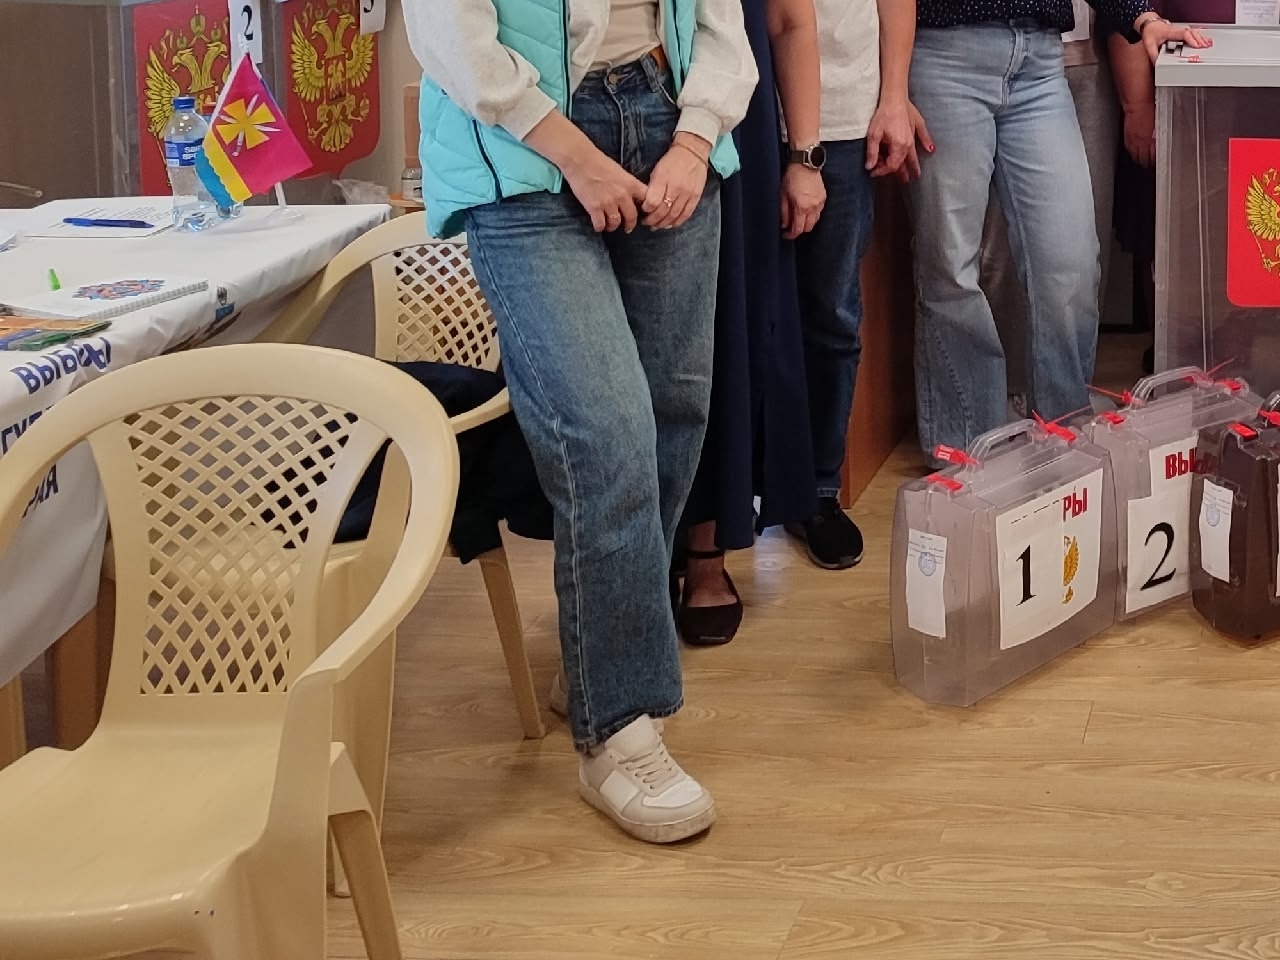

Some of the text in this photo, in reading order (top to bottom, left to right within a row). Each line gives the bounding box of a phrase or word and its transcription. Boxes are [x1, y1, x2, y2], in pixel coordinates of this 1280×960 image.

[240, 5, 254, 40] 2
[1015, 544, 1036, 607] 1
[1139, 521, 1177, 592] 2
